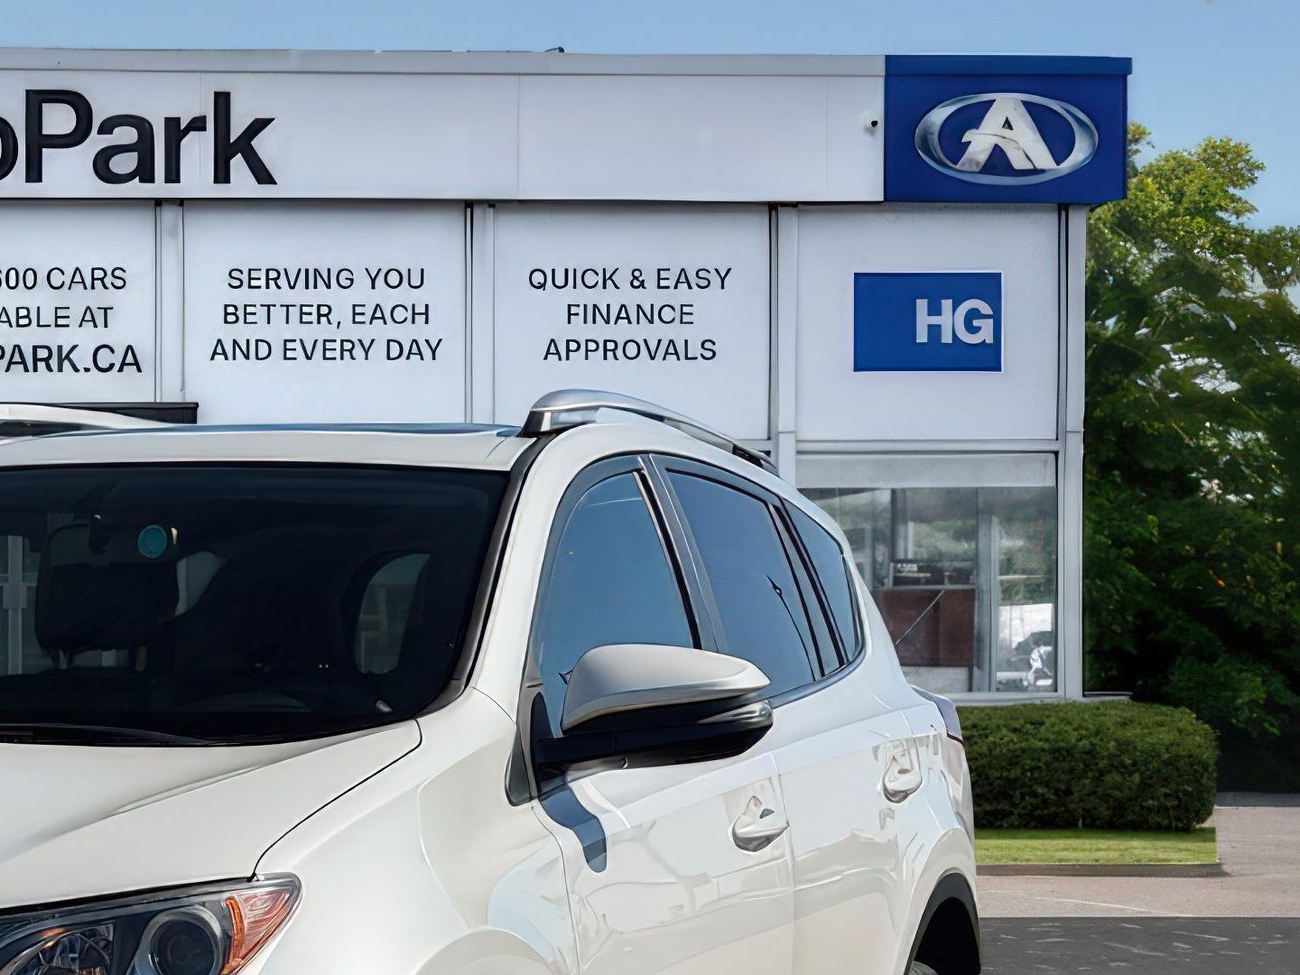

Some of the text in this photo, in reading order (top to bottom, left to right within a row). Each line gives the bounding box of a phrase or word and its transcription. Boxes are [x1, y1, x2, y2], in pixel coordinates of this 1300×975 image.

[46, 266, 127, 291] CARS
[227, 267, 425, 290] SERVING YOU
[528, 267, 732, 292] QUICK & EASY
[78, 305, 114, 329] AT
[223, 303, 429, 330] BETTER, EACH
[567, 303, 694, 326] FINANCE
[915, 299, 994, 344] HG
[209, 338, 443, 361] AND EVERY DAY
[543, 338, 717, 362] APPROVALS
